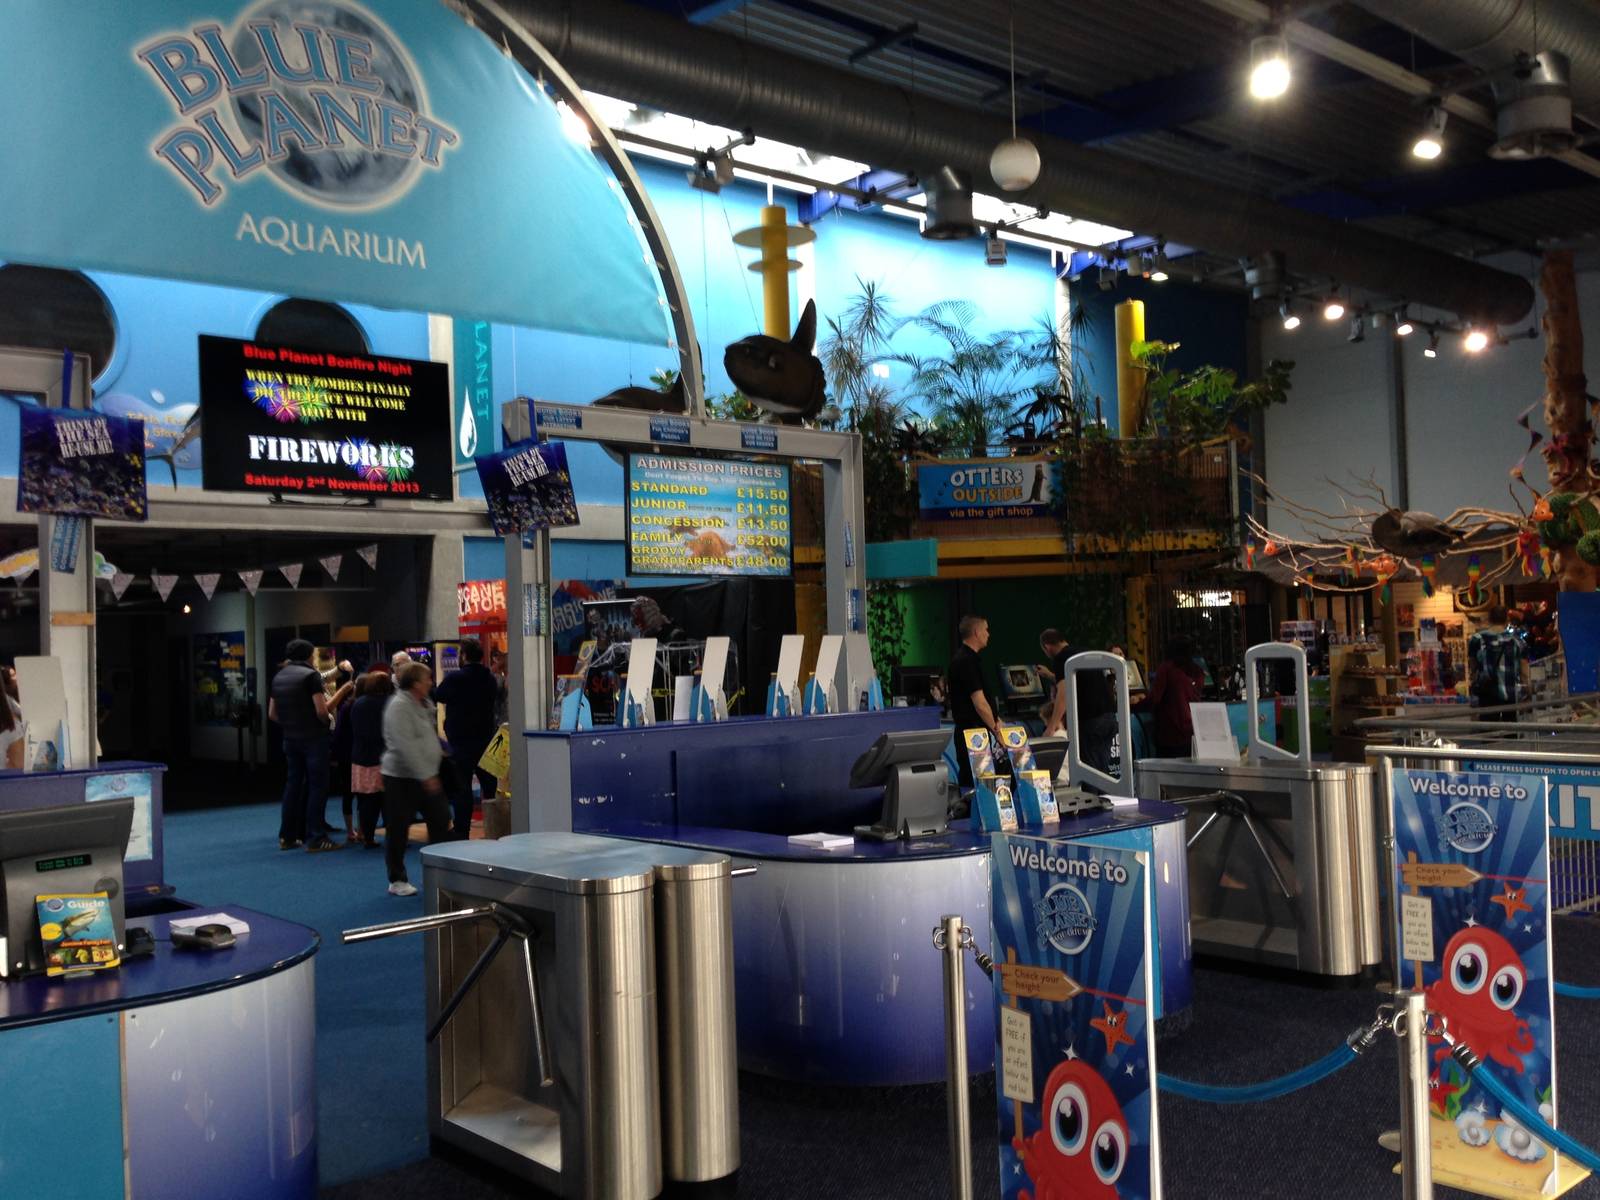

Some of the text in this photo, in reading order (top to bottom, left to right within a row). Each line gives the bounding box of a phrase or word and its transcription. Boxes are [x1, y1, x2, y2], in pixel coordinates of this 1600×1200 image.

[137, 23, 383, 115] BLUE
[156, 89, 457, 206] PLANET
[235, 213, 427, 269] AQUARIUM
[243, 344, 412, 377] Blue Planet Bonfire Night
[246, 369, 411, 397] WHEN THE ZOMBIES FINALLY
[346, 394, 374, 409] WILL
[375, 398, 406, 411] COME
[336, 409, 366, 422] WITH
[249, 435, 415, 469] FIREWORKS
[637, 457, 782, 479] ADMISSION PRICES
[950, 467, 1024, 486] OTTERS
[245, 473, 303, 490] Saturday
[328, 479, 388, 492] November
[391, 481, 419, 493] 2013
[631, 481, 787, 500] STANDARD £15.50
[952, 486, 1023, 503] OUTSIDE
[631, 498, 687, 511] JUNIOR
[736, 502, 787, 516] £11.50
[950, 507, 1033, 519] via the gift shop
[631, 515, 787, 531] CONCESSION £13.50
[631, 532, 787, 547] FAMILY £52.00
[631, 546, 687, 555] GROOVY
[631, 556, 733, 567] GRANDPARENTS
[735, 556, 787, 568] £48.00
[1476, 763, 1500, 773] PLEASE
[1502, 765, 1523, 774] PRESS
[1524, 766, 1556, 775] BUTTON
[1558, 767, 1569, 776] TO
[1570, 768, 1591, 777] OPEN
[1410, 777, 1527, 799] Welcome to
[1009, 844, 1127, 883] Welcome to
[67, 899, 105, 908] Guide
[1015, 968, 1060, 985] Check your
[1015, 979, 1041, 993] height
